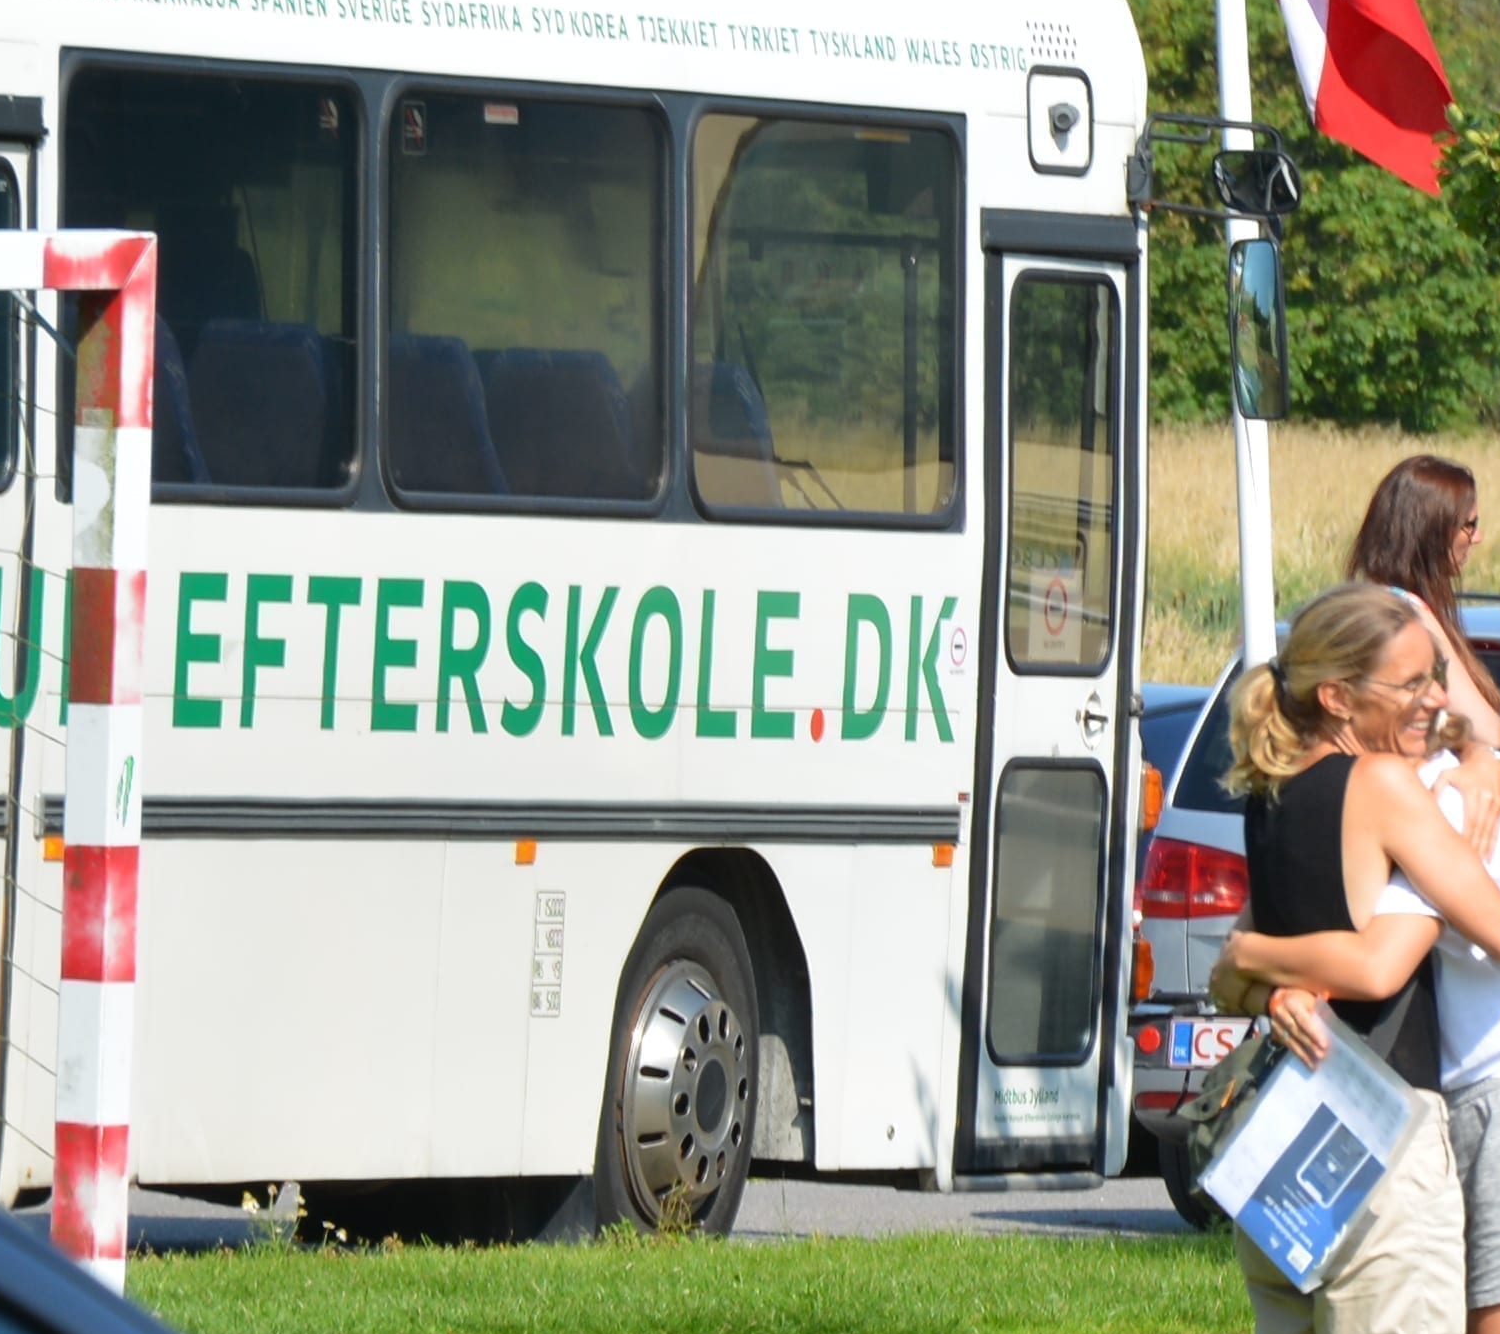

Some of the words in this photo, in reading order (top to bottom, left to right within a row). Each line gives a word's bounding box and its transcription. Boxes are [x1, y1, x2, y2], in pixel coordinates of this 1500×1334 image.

[422, 0, 523, 32] SYDAFRIKA
[532, 7, 565, 35] SYD
[570, 11, 629, 42] KOREA
[637, 15, 718, 48] TJEKKIET
[728, 23, 800, 54] TYRKIET
[809, 29, 896, 62] TYSKLAND
[905, 36, 962, 67] WALES
[970, 44, 1027, 72] ØSTRIG
[172, 571, 958, 743] EFTERSKOLE.DK
